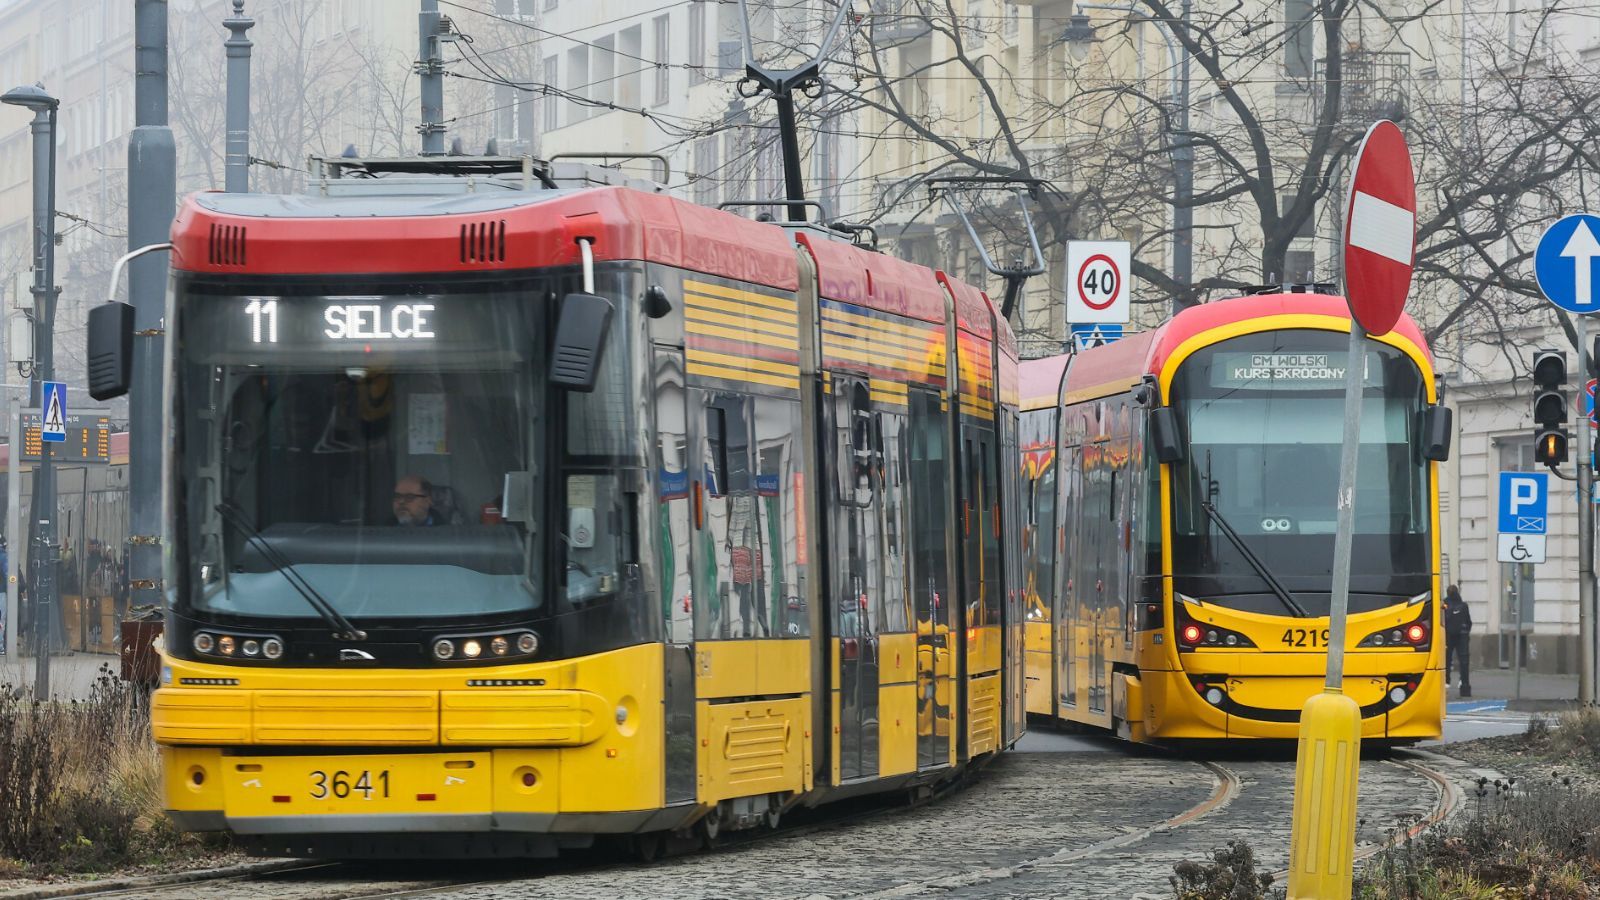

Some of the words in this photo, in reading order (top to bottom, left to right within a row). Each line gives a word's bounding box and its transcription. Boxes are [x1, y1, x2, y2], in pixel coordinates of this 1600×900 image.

[1083, 268, 1115, 296] 40
[244, 299, 278, 343] 11
[324, 304, 435, 339] SIELCE
[1234, 368, 1271, 379] KURS
[1252, 355, 1273, 367] CM
[1278, 355, 1328, 367] WOLSKI
[1509, 477, 1538, 516] P
[1281, 628, 1330, 648] 4219
[308, 769, 391, 799] 3641
